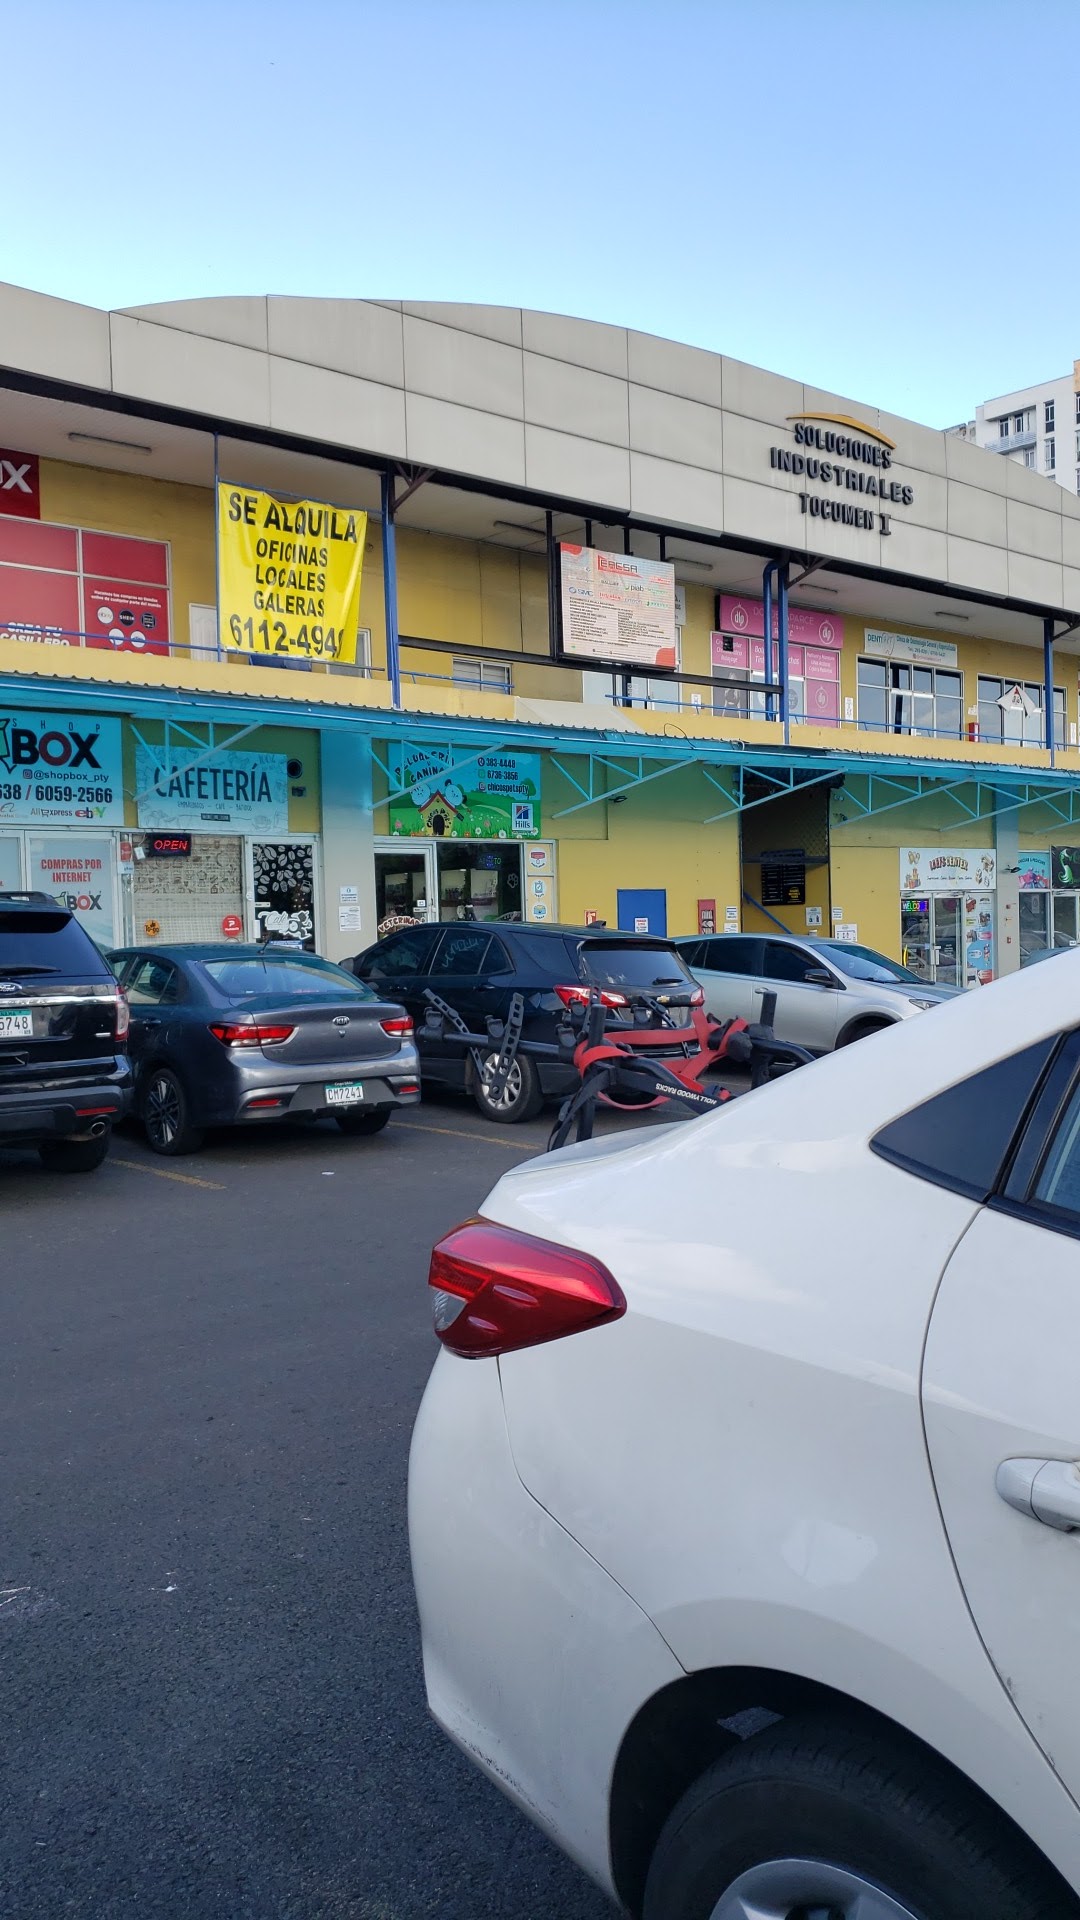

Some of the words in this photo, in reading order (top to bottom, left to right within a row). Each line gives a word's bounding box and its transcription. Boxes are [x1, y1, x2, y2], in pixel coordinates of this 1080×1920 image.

[794, 423, 892, 469] SOLUCIONES
[770, 447, 914, 505] INDUSTRIALES
[229, 491, 258, 526] SE
[264, 503, 357, 543] ALQUILA
[799, 492, 874, 530] TOCUMEN
[879, 513, 891, 536] I
[256, 538, 328, 567] OFICINAS
[256, 564, 326, 592] LOCALES
[254, 590, 324, 618] GALERAS
[11, 728, 102, 768] BOX
[486, 758, 516, 768] 383-4448
[34, 770, 109, 782] @shopbox_pty
[154, 763, 272, 802] CAFETERÍA
[35, 785, 112, 803] 6059-2566
[154, 840, 188, 850] OPEN
[41, 859, 83, 870] COMPRAS
[85, 859, 102, 869] POR
[52, 872, 91, 882] INTERNET
[67, 894, 102, 910] BOX
[328, 1086, 361, 1100] CM7241
[656, 1083, 677, 1094] RACKS
[677, 1090, 717, 1105] HOLLYWOOD
